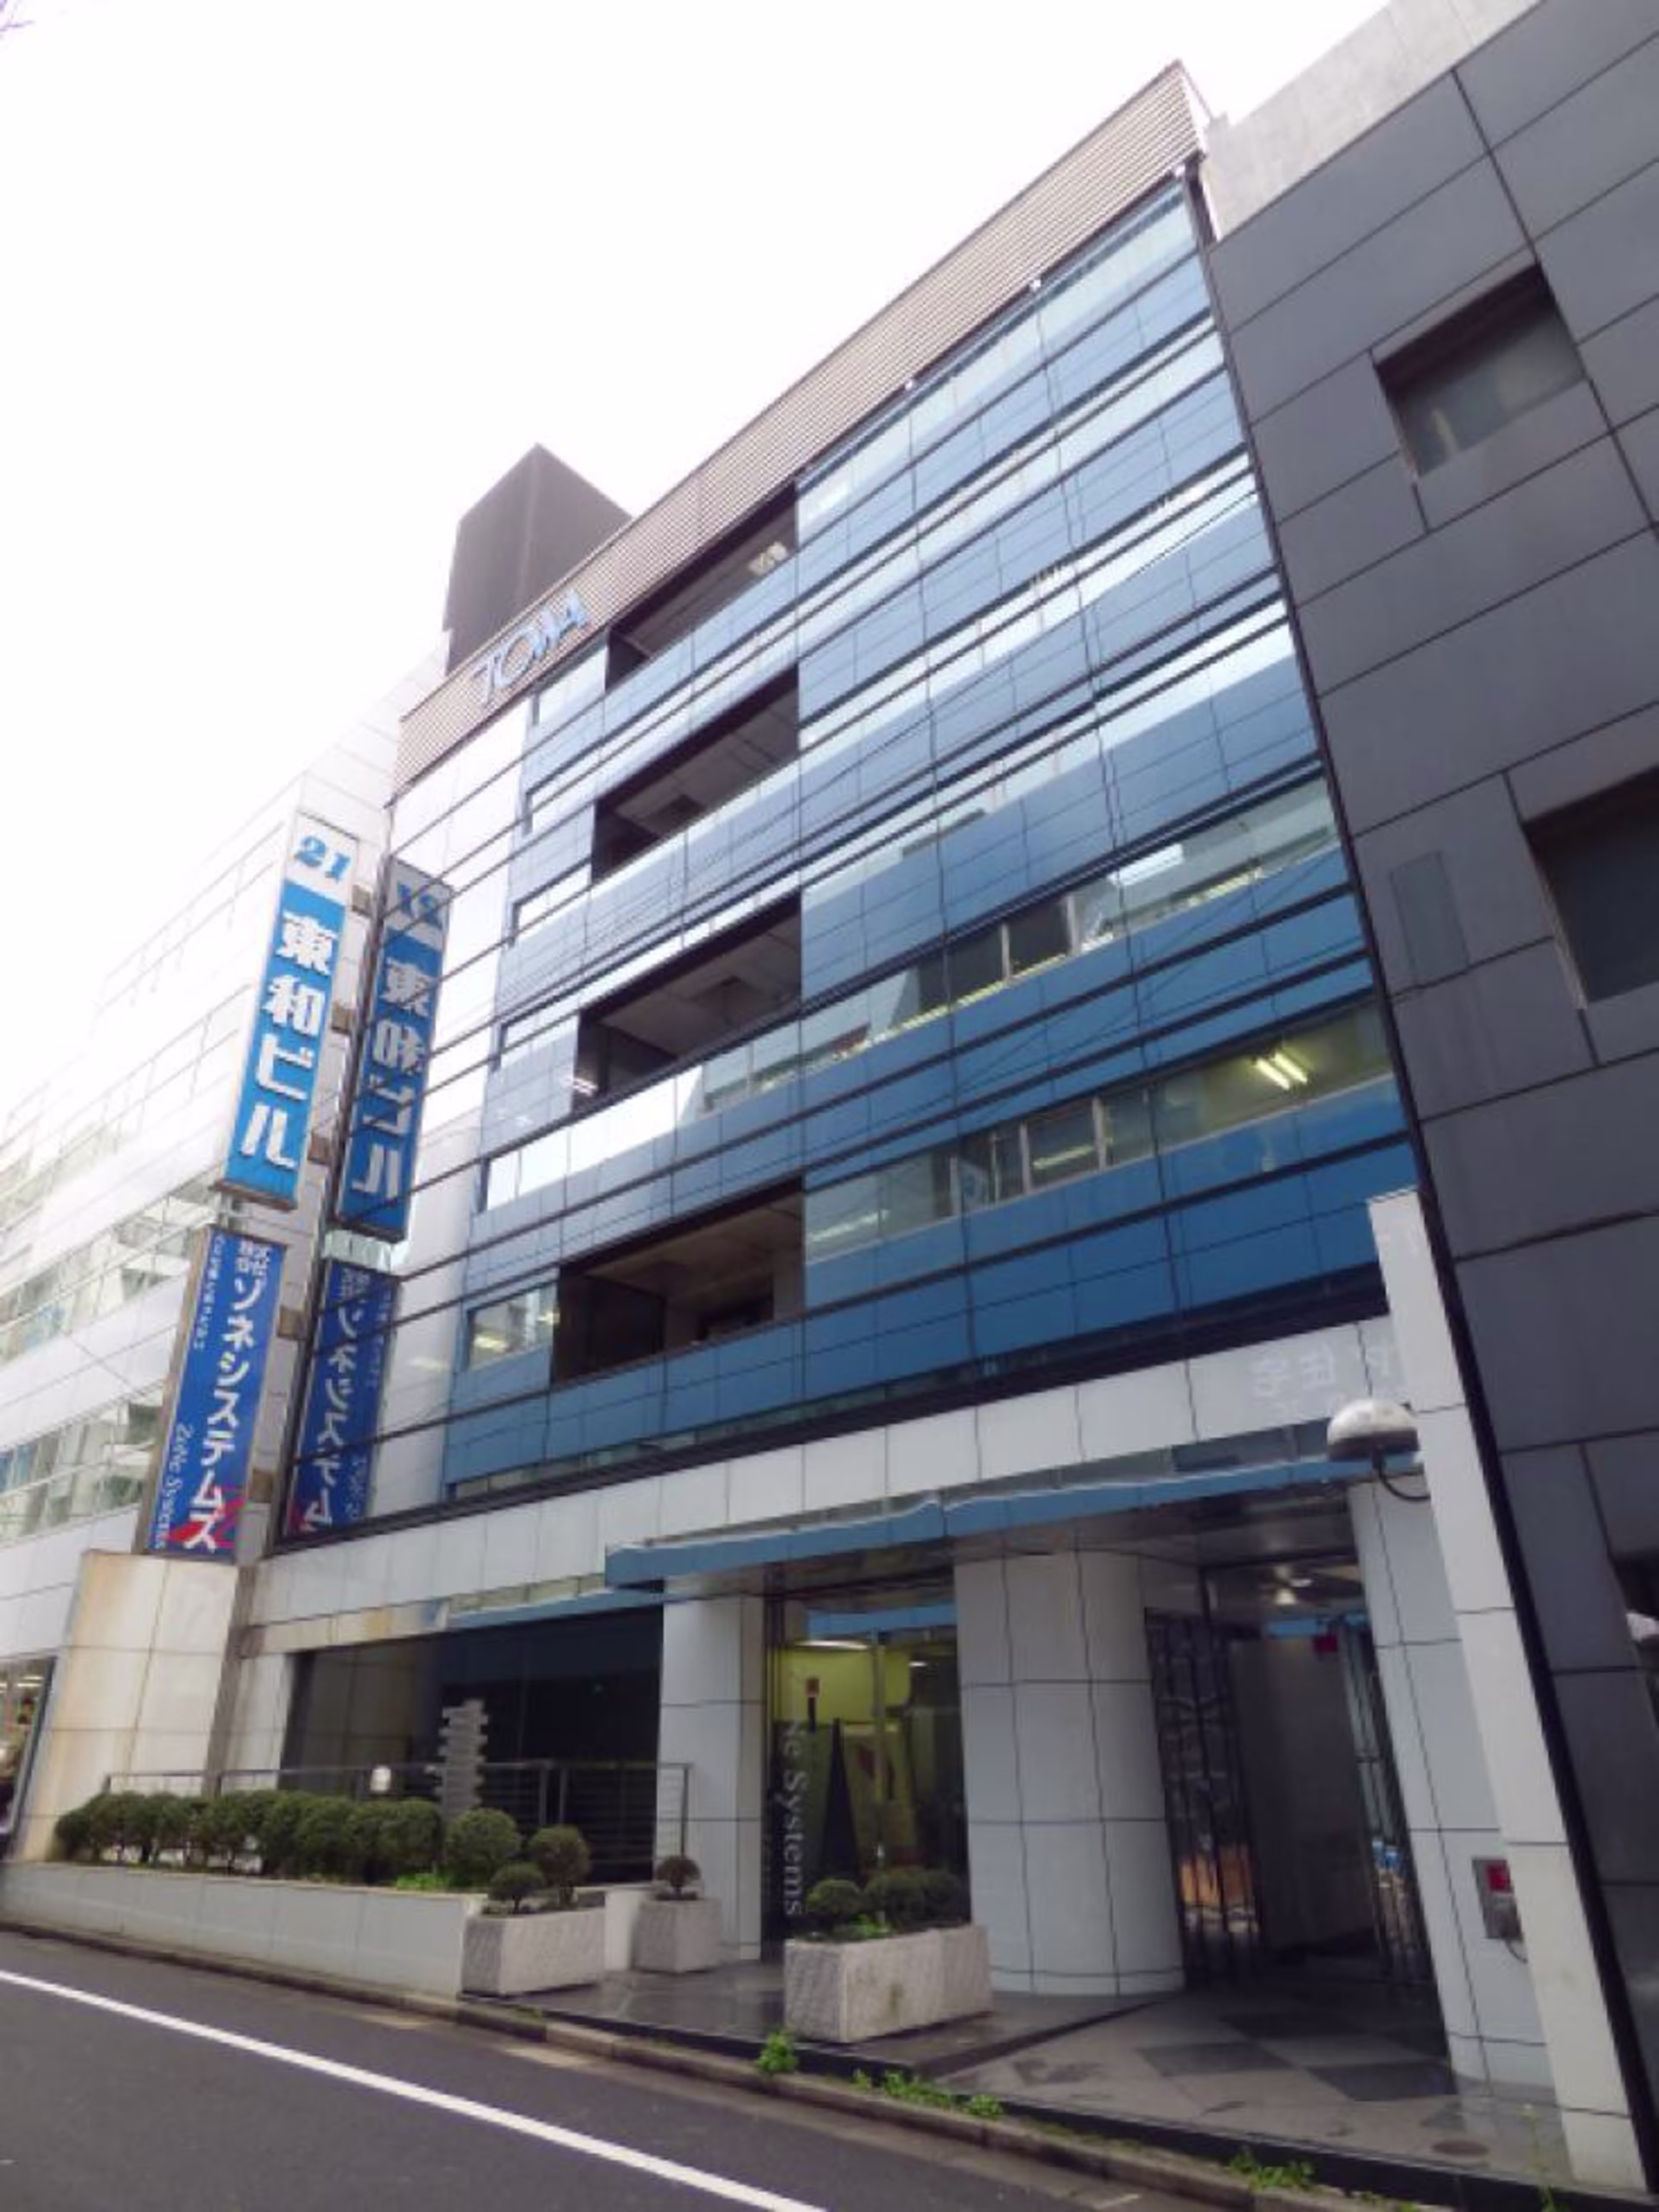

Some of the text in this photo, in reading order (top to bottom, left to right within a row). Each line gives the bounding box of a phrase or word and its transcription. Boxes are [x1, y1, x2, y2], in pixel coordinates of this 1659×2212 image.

[295, 835, 352, 884] 21
[240, 909, 338, 1170] 東和ビル
